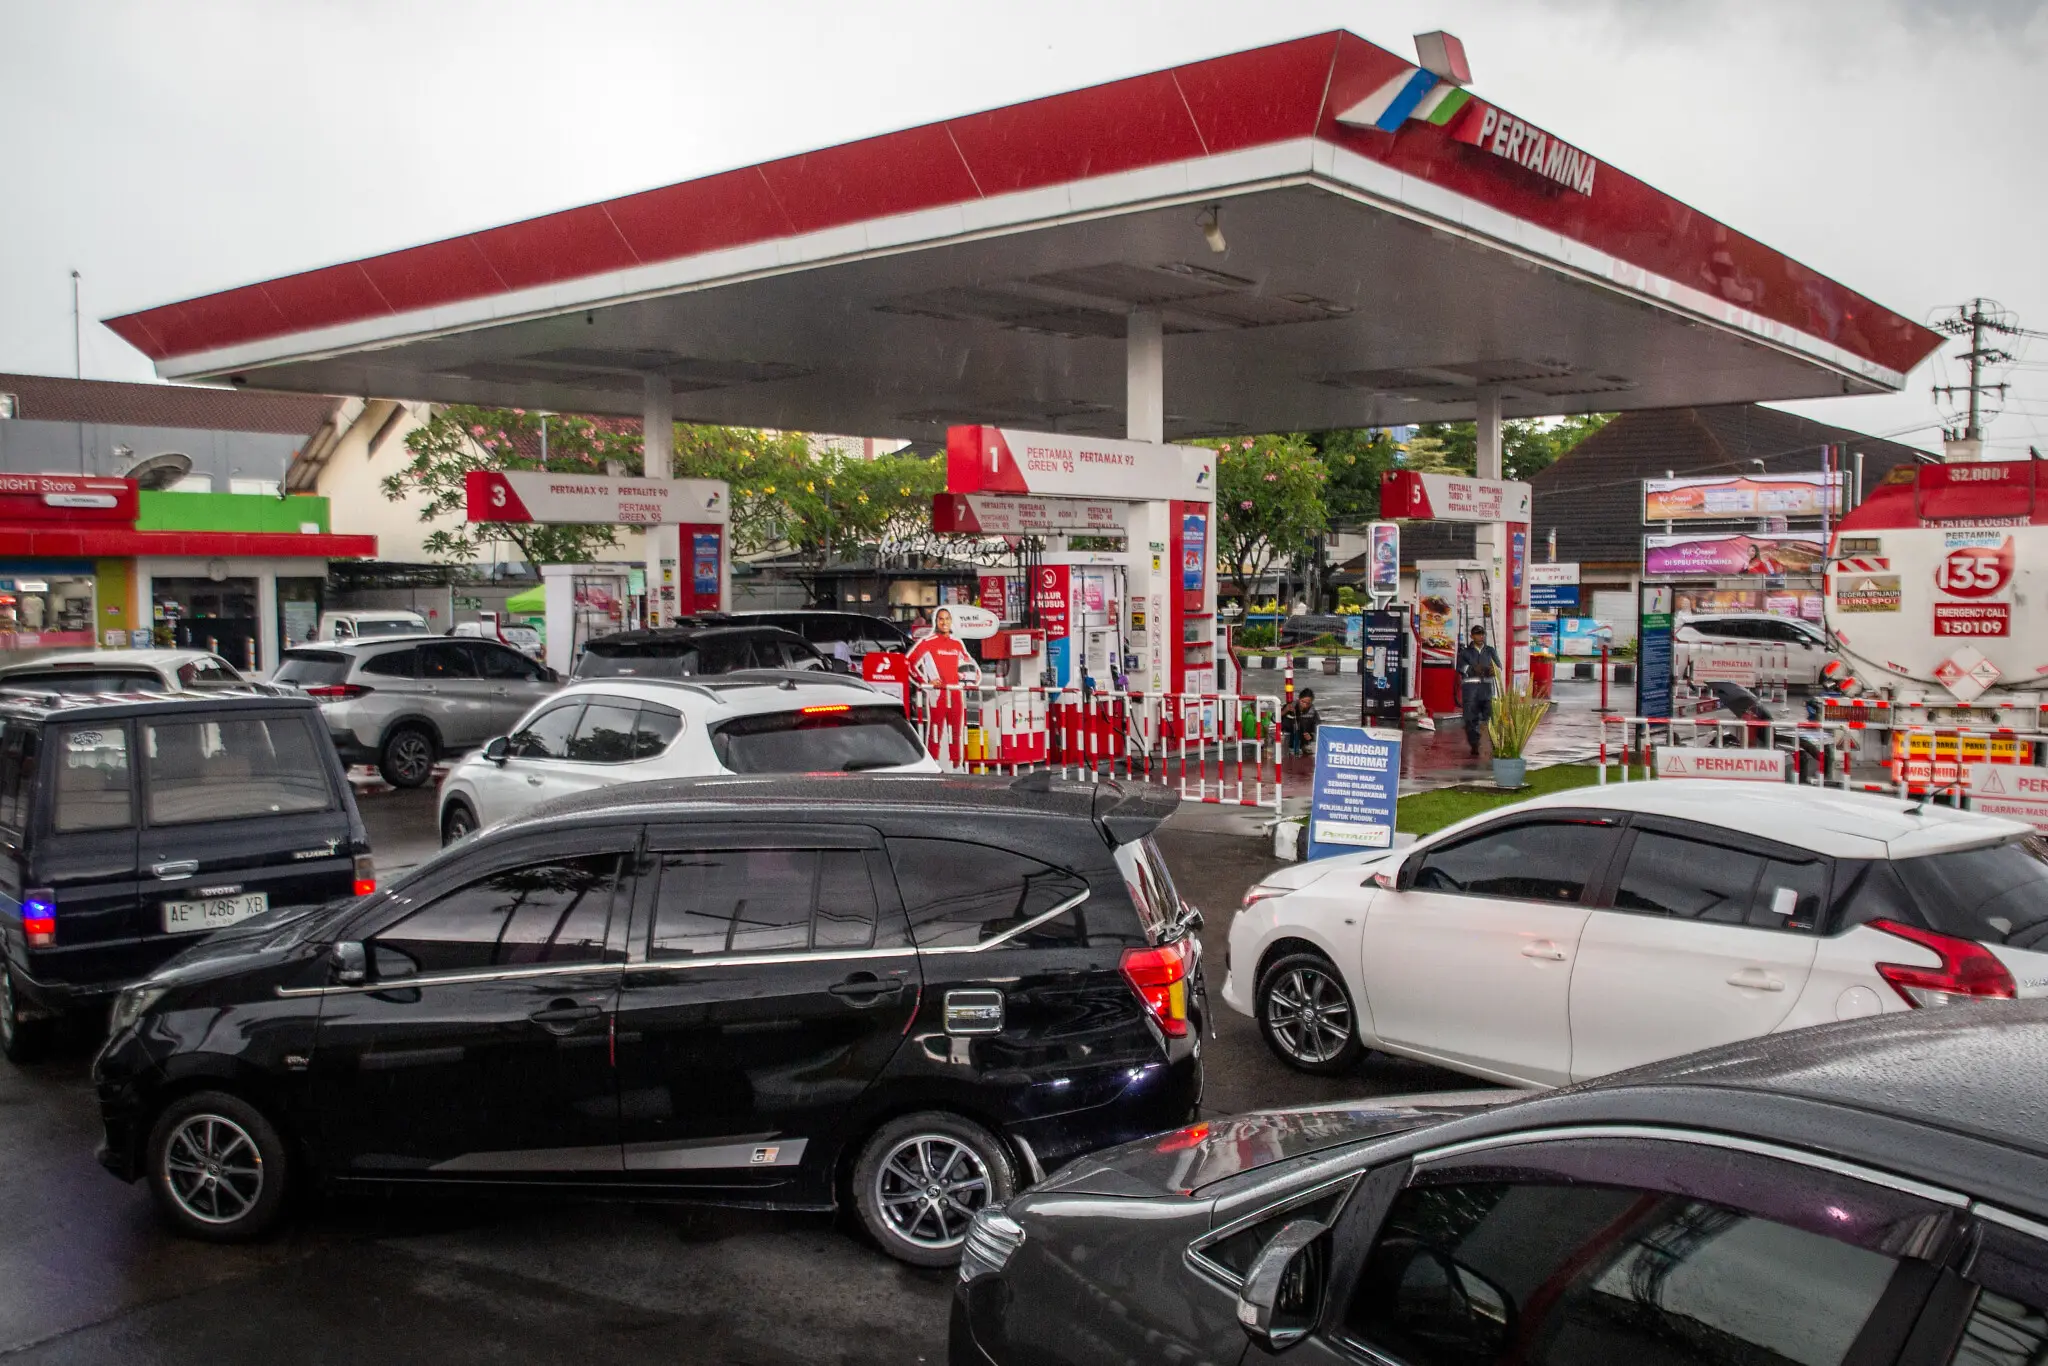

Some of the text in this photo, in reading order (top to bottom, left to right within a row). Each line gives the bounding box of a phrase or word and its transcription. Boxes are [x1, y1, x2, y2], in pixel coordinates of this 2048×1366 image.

[1476, 106, 1597, 198] PERTAMINA
[989, 447, 999, 473] 1
[1027, 447, 1073, 461] PERTAMAX
[1080, 451, 1135, 466] PERTAMAX 92
[1028, 461, 1075, 473] GREEN 95
[1950, 467, 1999, 481] 32.000
[42, 479, 76, 492] Store
[550, 485, 609, 496] PERTAMAX 92
[1448, 483, 1472, 493] PERTAMAX
[491, 483, 506, 507] 3
[618, 487, 668, 498] PERTALITE 90
[1413, 484, 1421, 504] 5
[619, 503, 661, 513] PERTAMAX
[957, 505, 966, 521] 7
[1448, 503, 1472, 512] PERTAMAX
[619, 512, 662, 522] GREEN 95
[1978, 516, 2032, 528] LOGISTIK
[1945, 531, 2001, 540] PERTAMINA
[1939, 557, 2000, 589] 135
[1871, 597, 1897, 605] SPOT
[1936, 607, 2008, 618] EMERGENCY CALL
[1942, 621, 2002, 634] 150109
[1711, 660, 1753, 668] PERHATIAN
[1329, 742, 1388, 756] PELANGGAN
[1900, 740, 1921, 748] AAS
[1965, 742, 1997, 750] PANJG
[2005, 744, 2028, 752] LEAR
[1328, 754, 1388, 768] TERHORMAT
[1695, 757, 1779, 773] PERHATIAN
[1327, 780, 1384, 791] SEDANG DILAKUKAN
[2018, 777, 2048, 792] PER
[1323, 788, 1387, 799] KEGIATAN BONGKARAN
[1319, 804, 1352, 812] PENJUALAN
[1360, 807, 1389, 815] HENTIKAN
[1981, 804, 2024, 815] DILARANG
[1350, 814, 1373, 822] PRODUK
[201, 887, 236, 896] TOYOTA
[171, 896, 263, 923] AE 1486 XB
